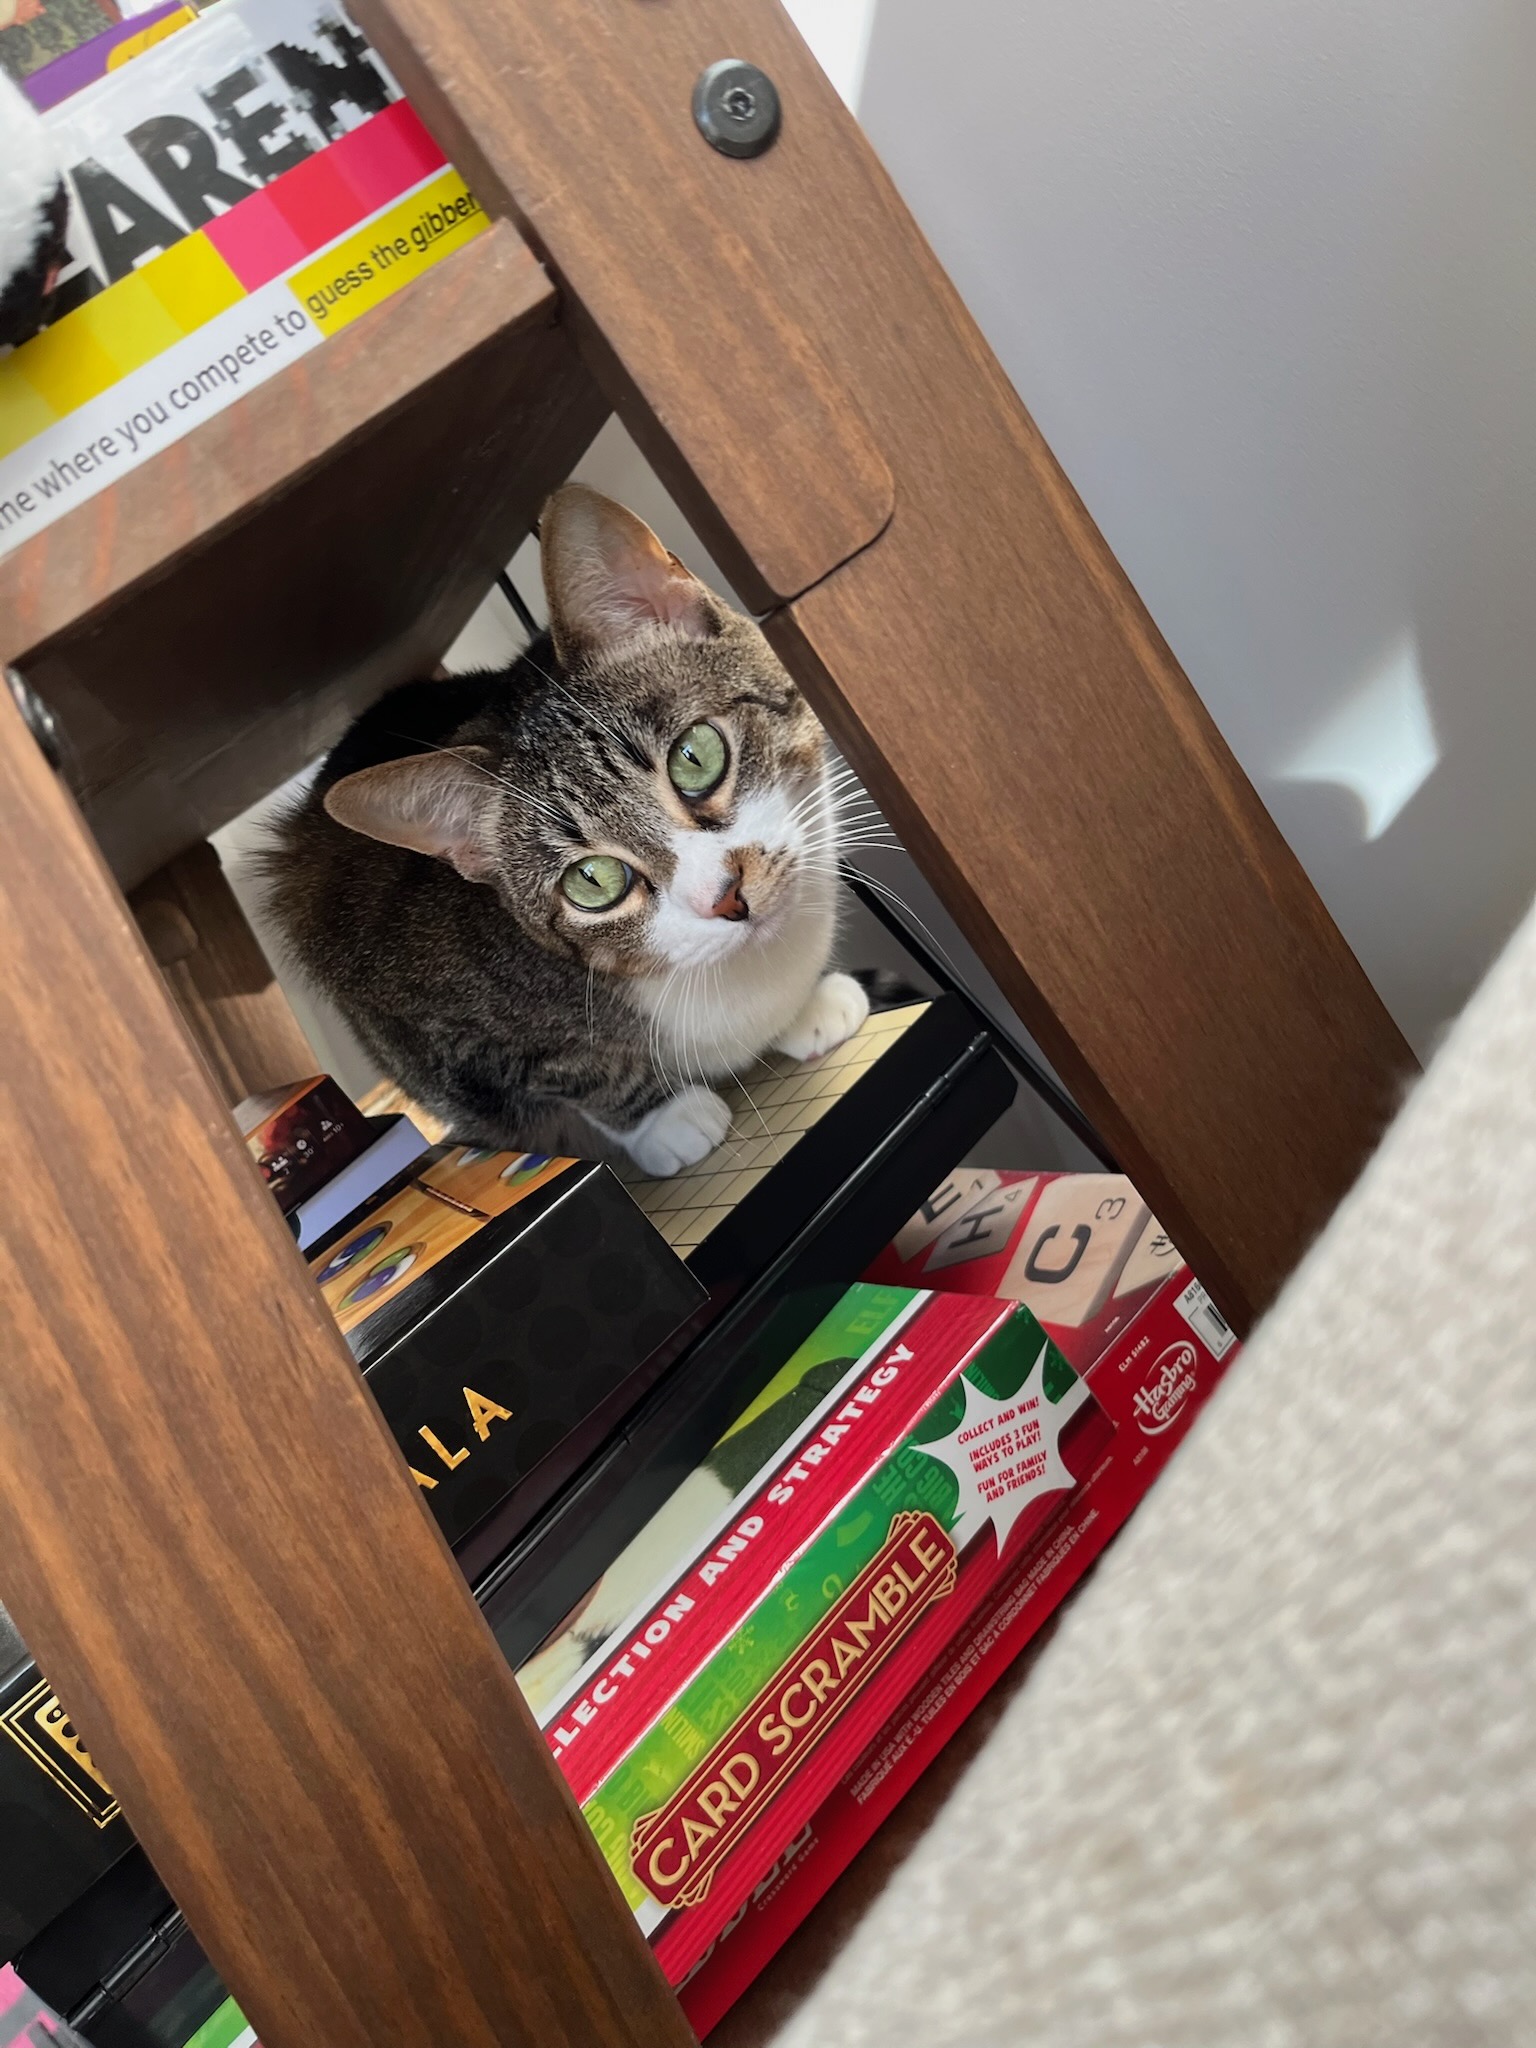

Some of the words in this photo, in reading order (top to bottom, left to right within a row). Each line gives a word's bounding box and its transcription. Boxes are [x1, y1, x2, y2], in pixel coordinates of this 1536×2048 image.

[32, 436, 119, 499] where
[115, 401, 170, 452] you
[169, 329, 278, 410] compete
[273, 310, 307, 337] to
[306, 262, 375, 320] guess
[370, 237, 411, 270] the
[947, 1204, 1005, 1250] H
[1024, 1223, 1092, 1284] C
[1095, 1197, 1126, 1220] 3
[1133, 1348, 1193, 1416] Hasbro
[1152, 1373, 1196, 1421] Gaming
[958, 1419, 994, 1445] COLLECT
[997, 1409, 1016, 1426] AND
[1017, 1396, 1040, 1415] WIN!
[969, 1433, 1012, 1462] INCLUDES
[1014, 1429, 1020, 1440] 3
[1022, 1419, 1040, 1436] FUN
[698, 1514, 765, 1587] AND
[766, 1343, 915, 1506] STRATEGY
[973, 1453, 1000, 1473] WAYS
[1001, 1446, 1014, 1458] TO
[1016, 1430, 1042, 1452] PLAY!
[977, 1477, 996, 1494] FUN
[998, 1467, 1014, 1483] FOR
[1016, 1450, 1047, 1475] FAMILY
[986, 1485, 1004, 1503] AND
[1006, 1463, 1046, 1491] FRIENDS!
[648, 1752, 761, 1886] CARD
[757, 1527, 947, 1755] SCRAMBLE
